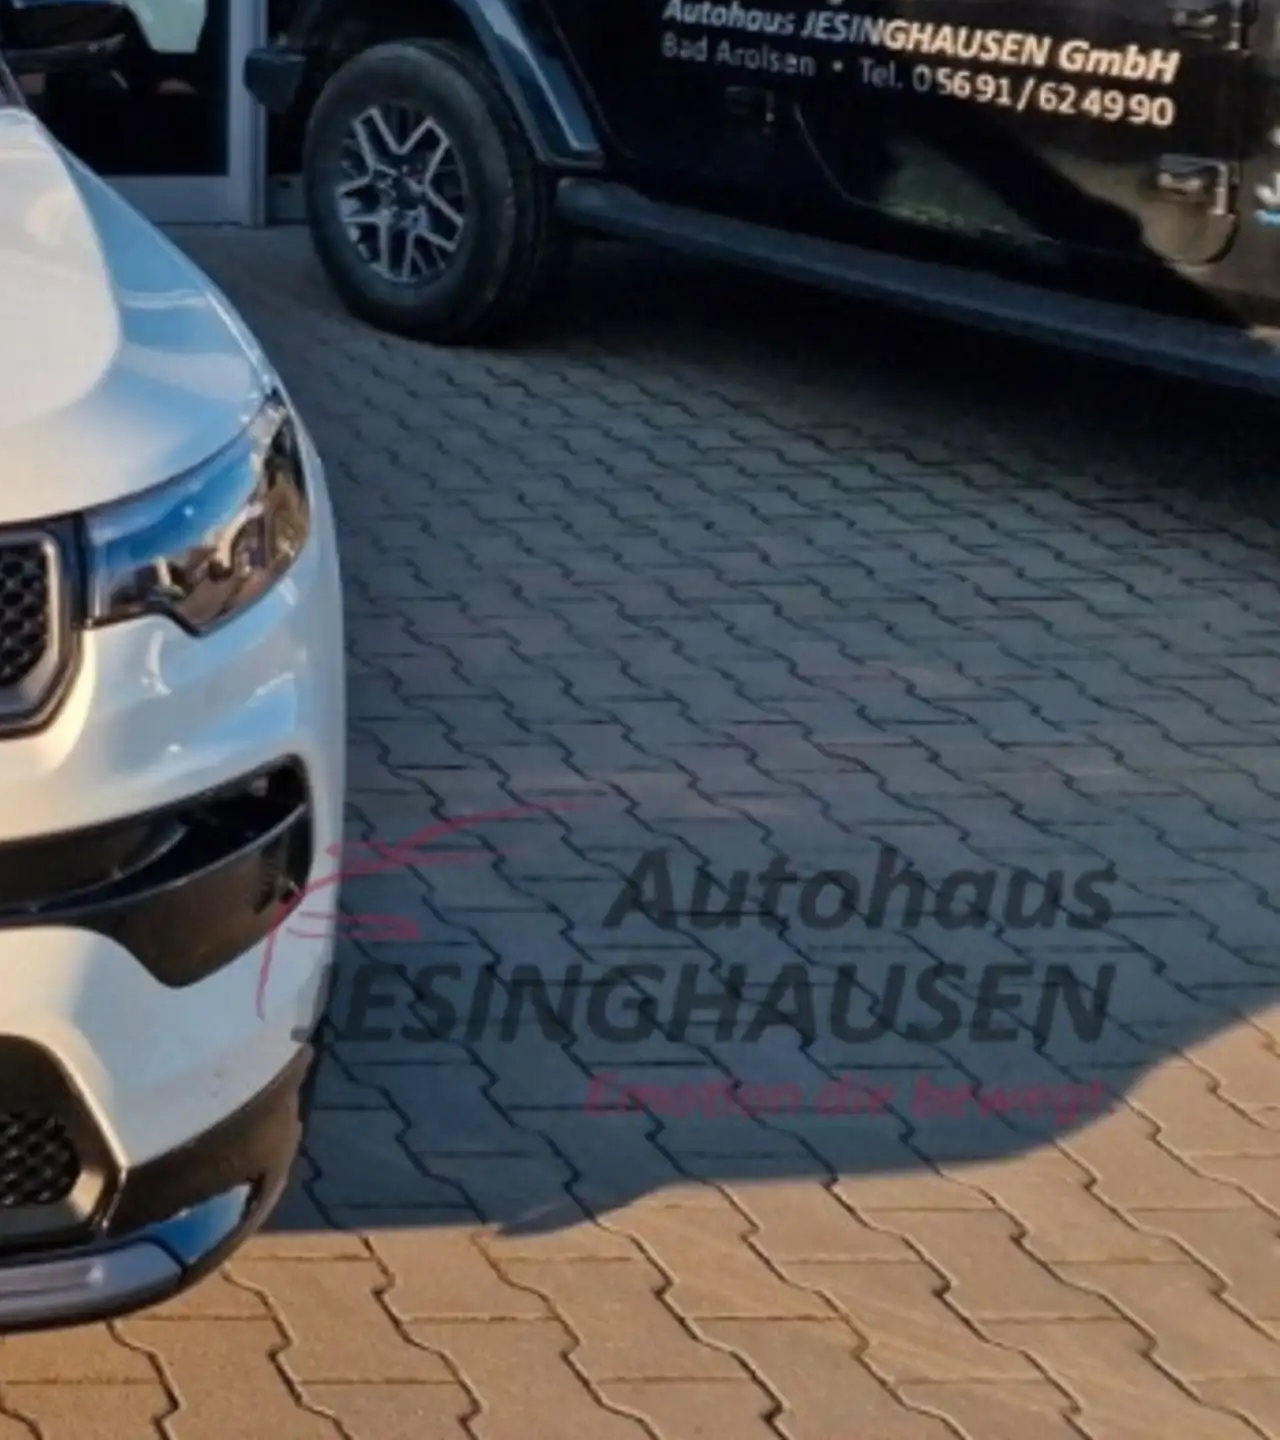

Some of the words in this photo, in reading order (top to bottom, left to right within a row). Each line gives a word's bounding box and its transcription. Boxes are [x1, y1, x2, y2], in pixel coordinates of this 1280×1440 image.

[661, 31, 708, 62] Bad
[715, 39, 816, 77] Arolsen
[859, 56, 904, 88] Tel.
[800, 9, 1052, 67] JESINGHAUSEN
[1058, 40, 1181, 84] GmbH
